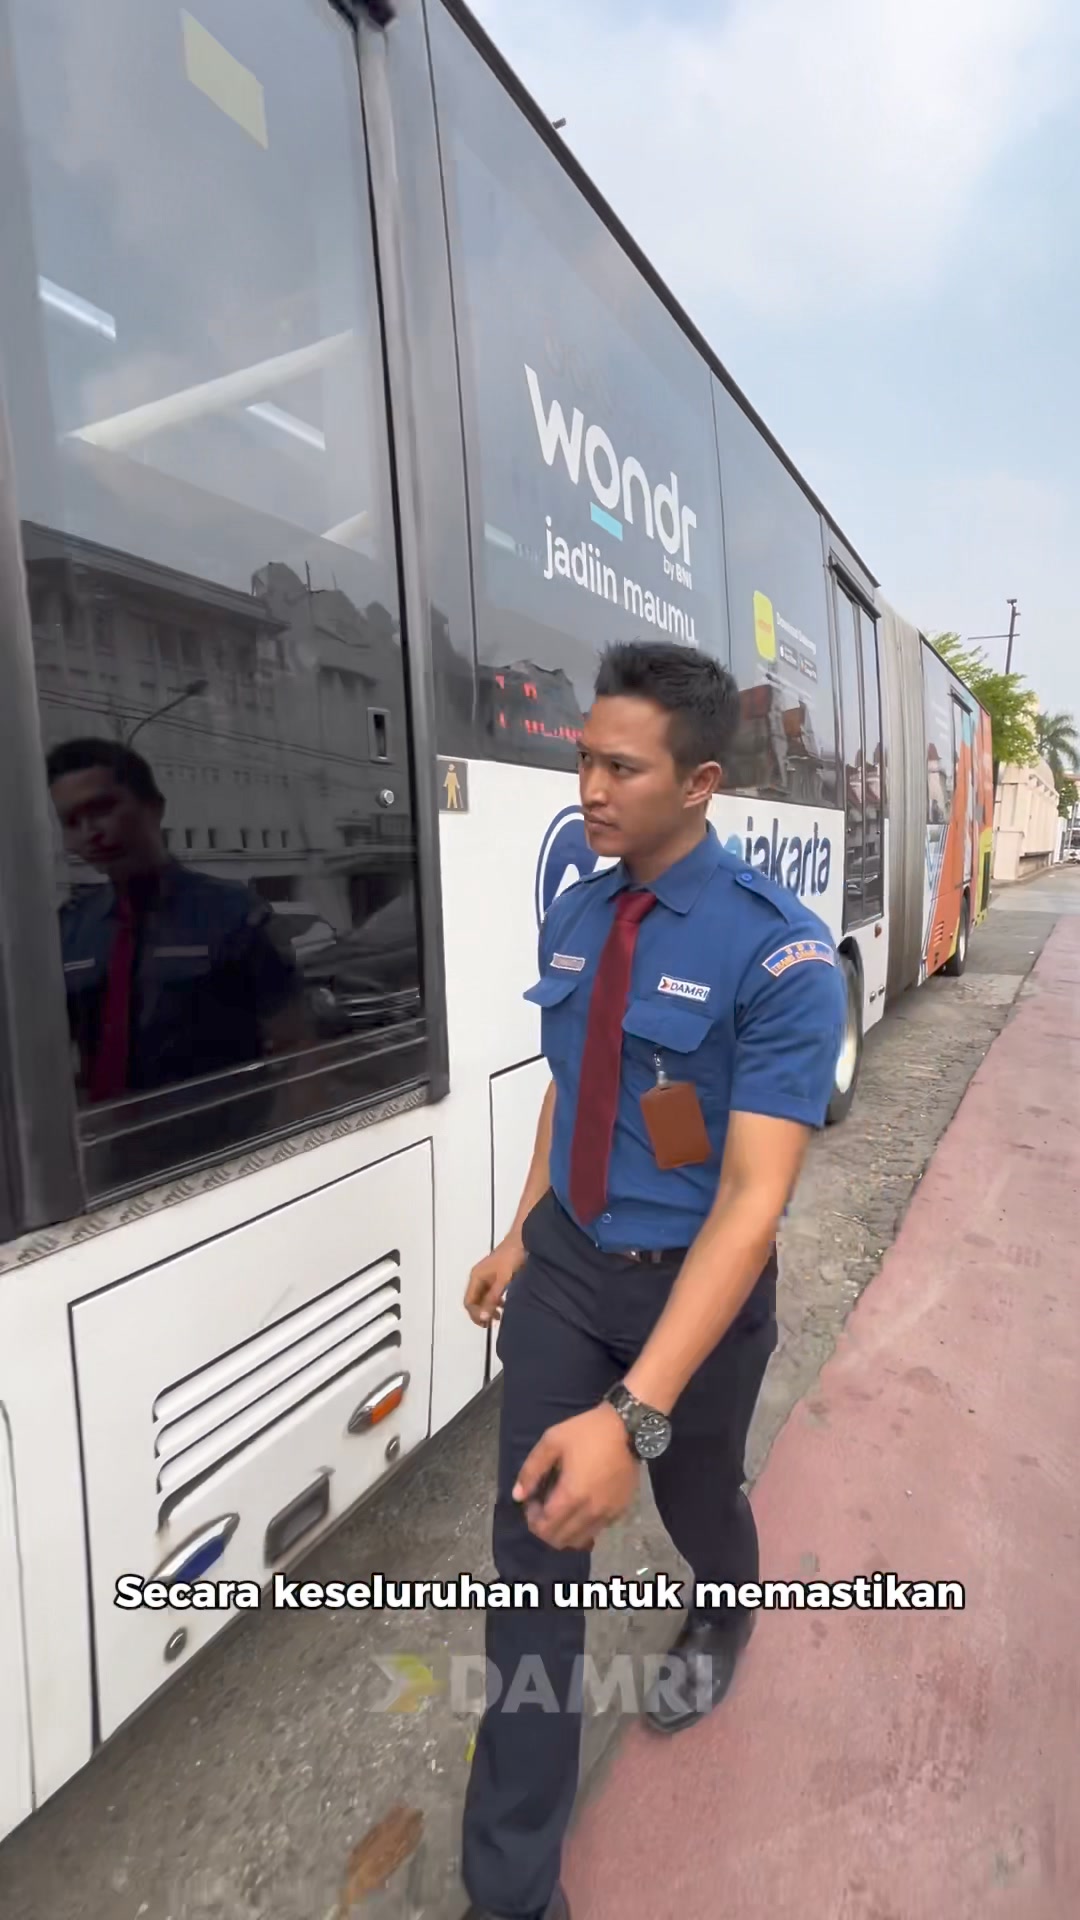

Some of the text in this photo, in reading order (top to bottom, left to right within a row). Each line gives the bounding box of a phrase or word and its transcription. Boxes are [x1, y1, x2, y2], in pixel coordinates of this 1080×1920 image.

[524, 363, 697, 566] wondr
[544, 516, 618, 604] jadiin
[623, 576, 697, 642] maumu
[663, 554, 674, 581] by
[723, 815, 832, 896] jakarta
[670, 982, 708, 999] DAMRI
